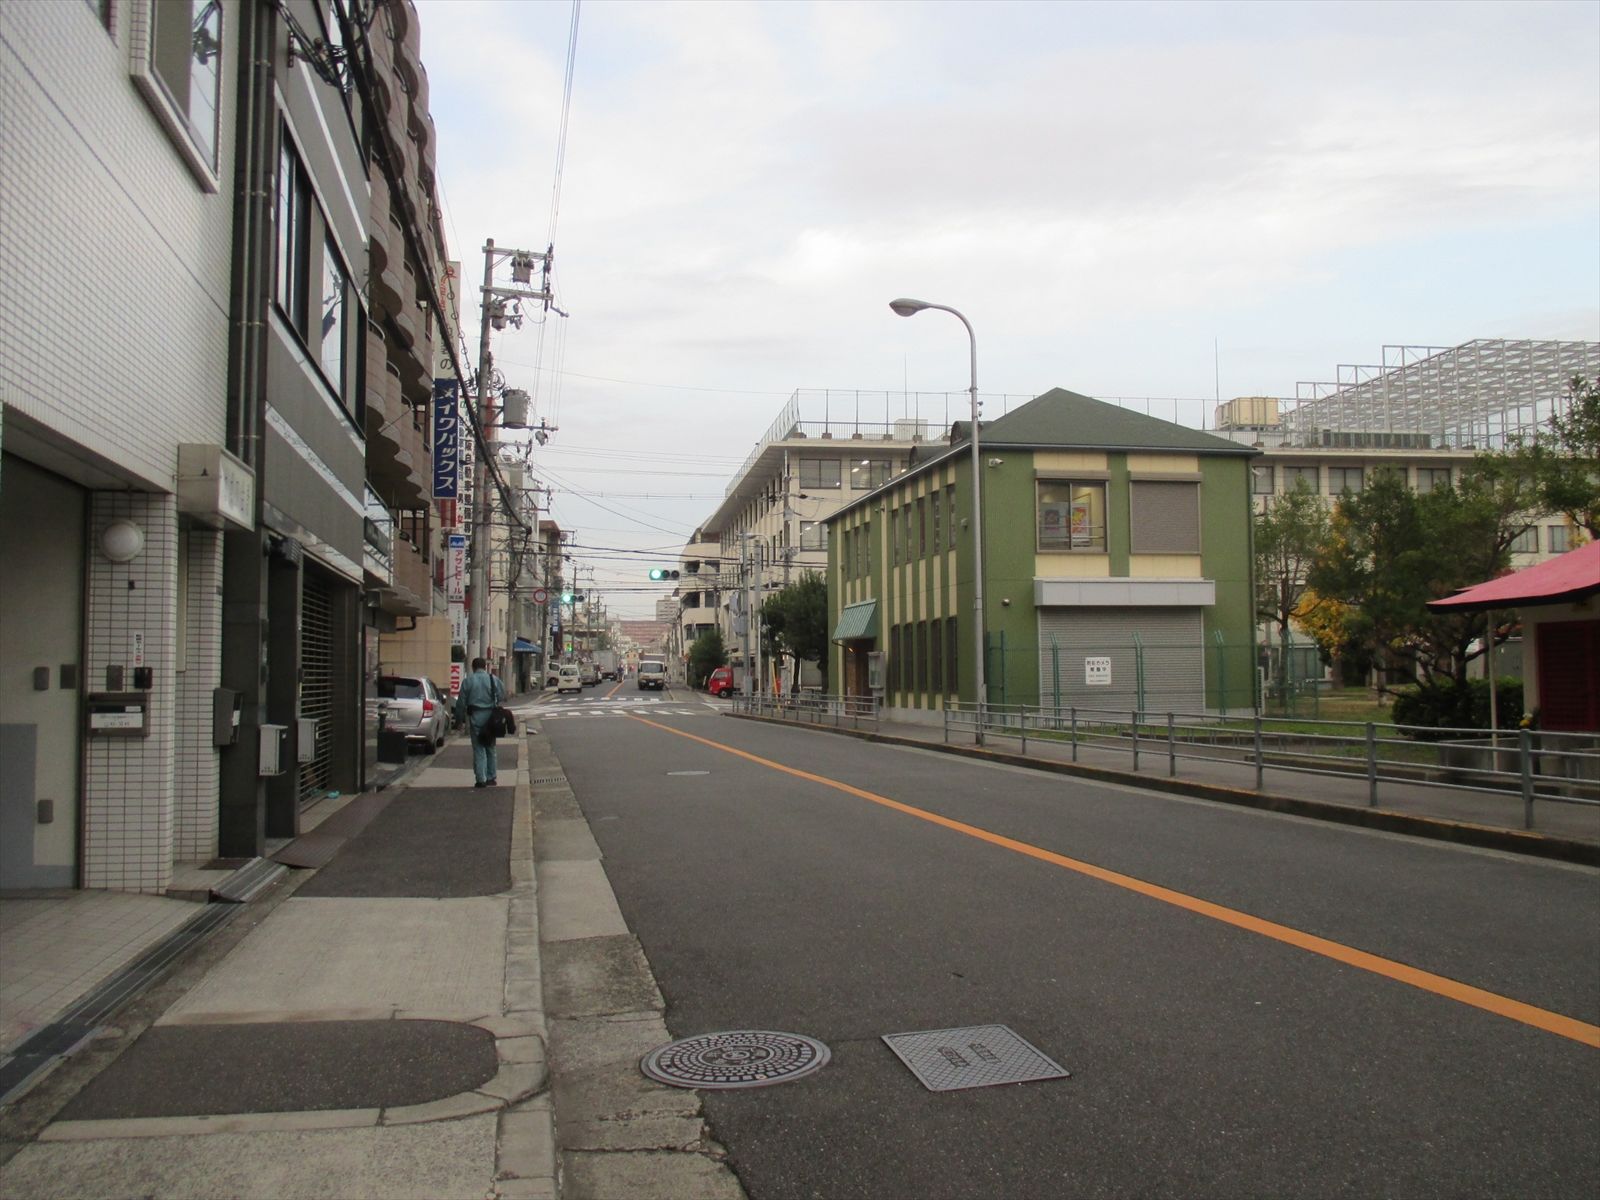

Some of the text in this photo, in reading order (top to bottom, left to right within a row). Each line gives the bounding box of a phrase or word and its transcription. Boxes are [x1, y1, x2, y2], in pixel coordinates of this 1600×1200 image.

[454, 549, 463, 594] アサヒビール
